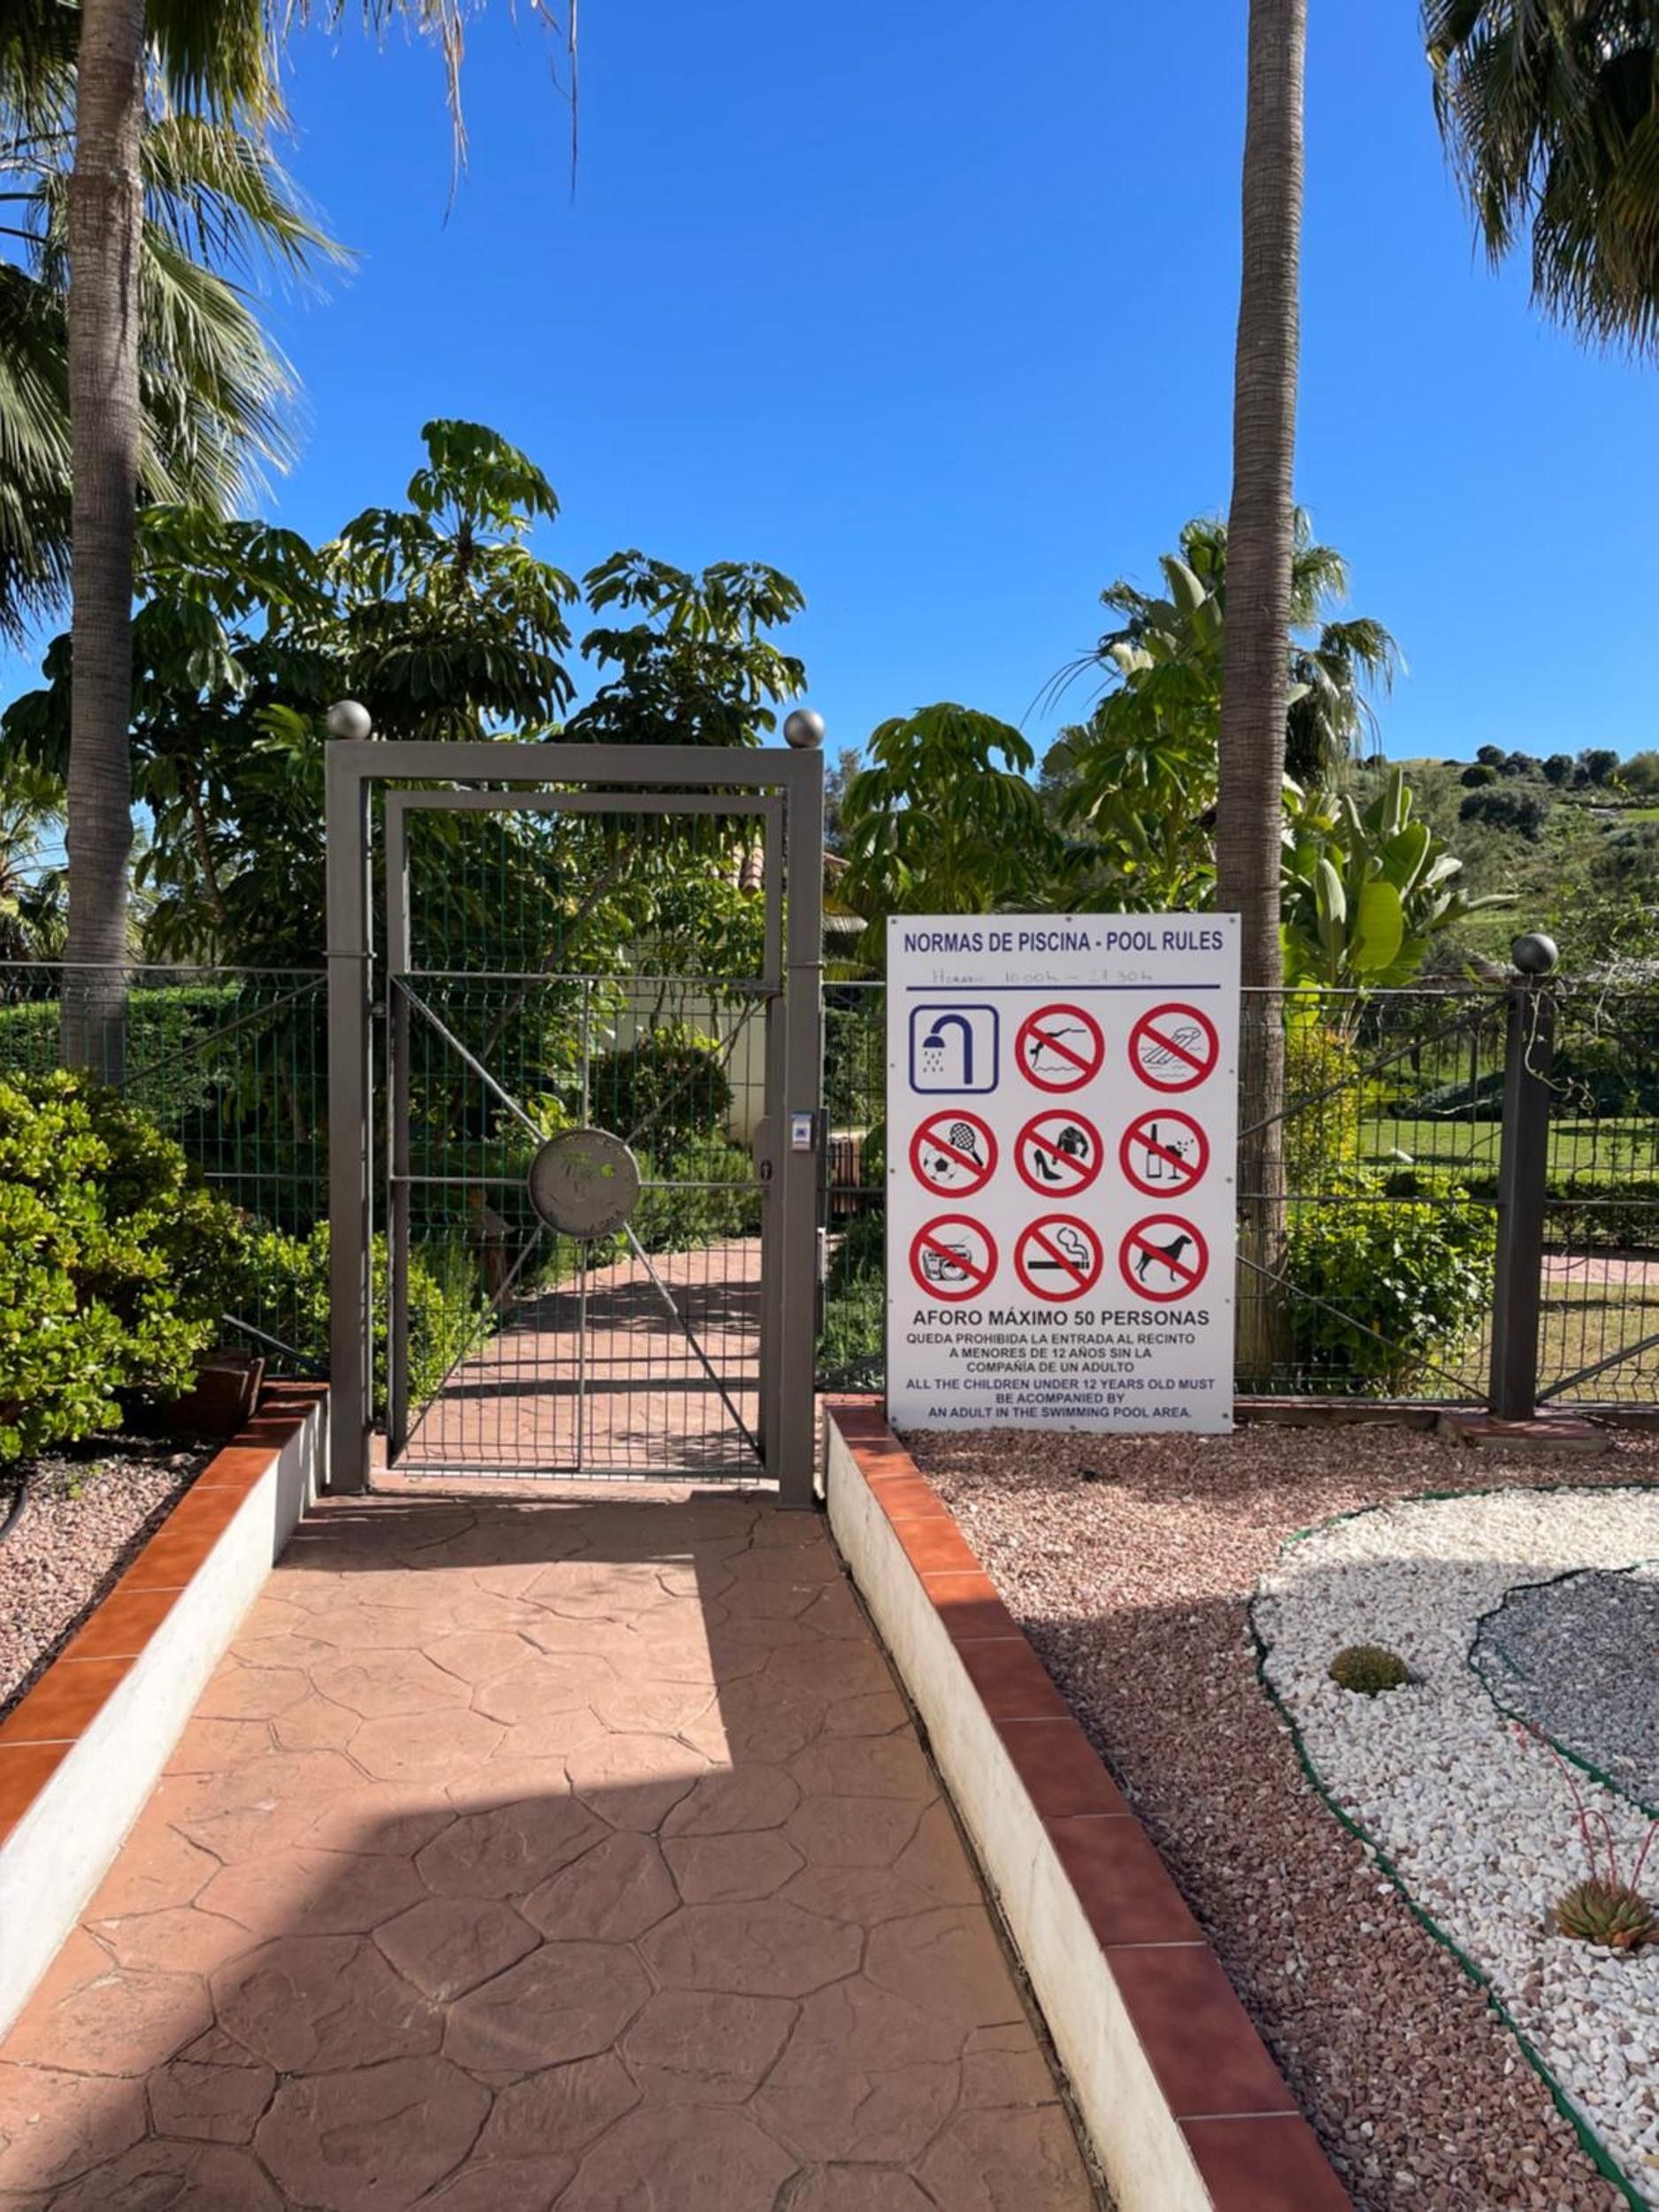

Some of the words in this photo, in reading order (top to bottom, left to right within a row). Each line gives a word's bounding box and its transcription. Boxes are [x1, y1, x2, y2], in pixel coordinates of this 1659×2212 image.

[904, 933, 983, 952] NORMAS
[989, 933, 1013, 952] DE
[1018, 932, 1091, 952] PISCINA
[1107, 931, 1157, 951] POOL
[1163, 931, 1224, 950] RULES
[913, 1310, 982, 1325] AFORO
[988, 1307, 1068, 1325] MÁXIMO
[1074, 1310, 1094, 1325] 50
[1102, 1310, 1210, 1325] PERSONAS
[907, 1333, 952, 1345] QUEDA
[956, 1333, 1027, 1344] PROHIBIDA
[1031, 1333, 1048, 1344] LA
[1051, 1333, 1114, 1344] ENTRADA
[1116, 1333, 1133, 1344] AL
[1138, 1333, 1195, 1344] RECINTO
[949, 1348, 958, 1358] A
[962, 1348, 1026, 1358] MENORES
[1030, 1348, 1048, 1358] DE
[1053, 1348, 1065, 1358] 12
[1069, 1345, 1106, 1358] AÑOS
[1110, 1348, 1131, 1358] SIN
[1135, 1348, 1152, 1358] LA
[1039, 1362, 1056, 1372] DE
[1060, 1362, 1079, 1373] UN
[1082, 1362, 1134, 1373] ADULTO
[906, 1379, 931, 1390] ALL
[935, 1379, 959, 1390] THE
[964, 1379, 1029, 1390] CHILDREN
[1033, 1379, 1079, 1390] UNDER
[1083, 1379, 1096, 1390] 12
[1101, 1379, 1144, 1390] YEARS
[1148, 1379, 1175, 1390] OLD
[1179, 1379, 1215, 1390] MUST
[996, 1394, 1012, 1404] BE
[1017, 1393, 1103, 1404] ACOMPANIED
[1107, 1394, 1125, 1404] BY
[928, 1408, 947, 1418] AN
[950, 1408, 991, 1418] ADULT
[996, 1408, 1009, 1418] IN
[1013, 1407, 1036, 1418] THE
[1041, 1407, 1109, 1418] SWIMMING
[1114, 1407, 1148, 1418] POOL
